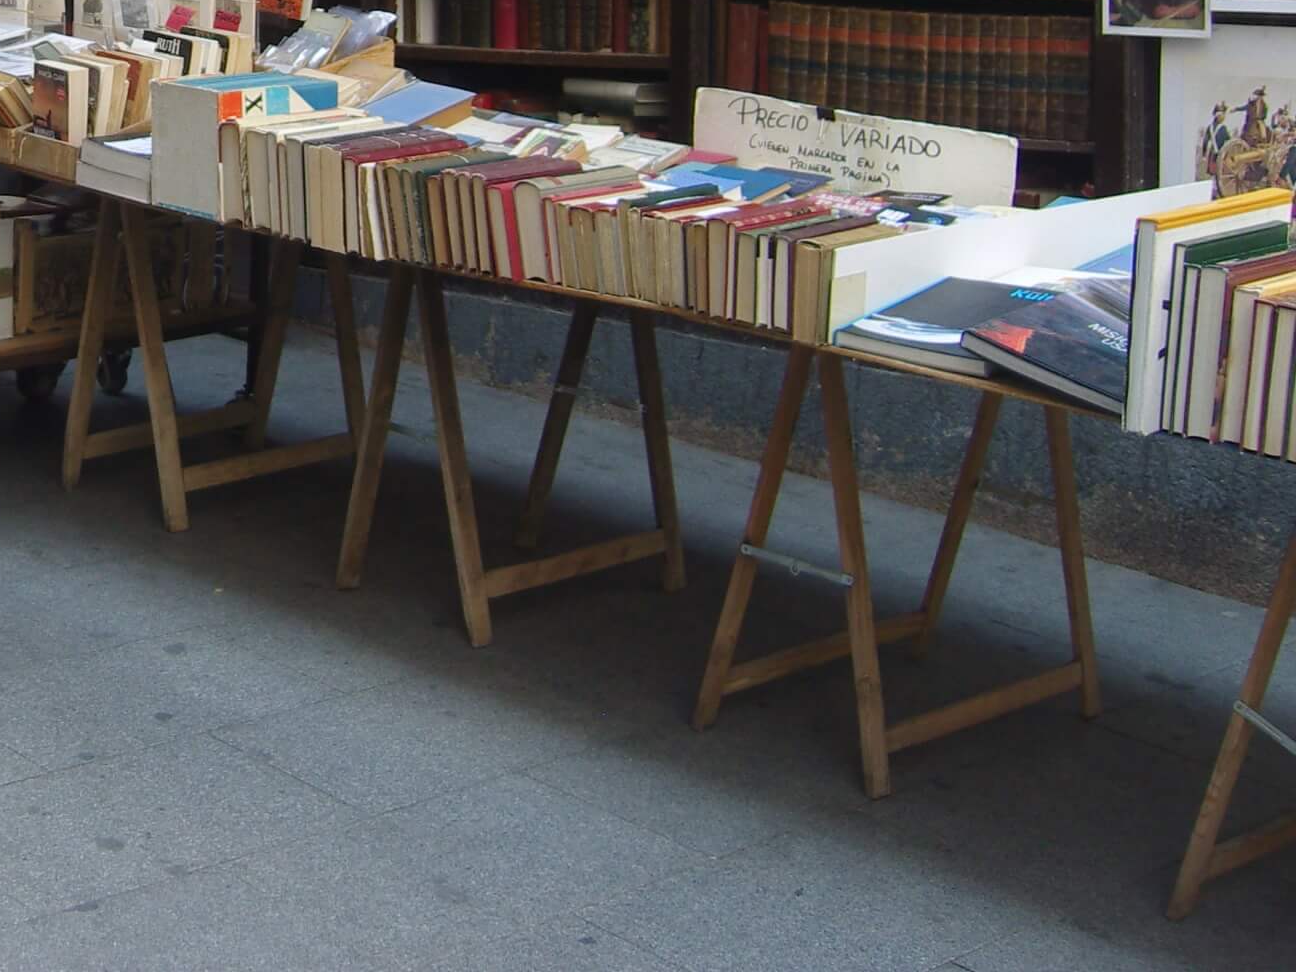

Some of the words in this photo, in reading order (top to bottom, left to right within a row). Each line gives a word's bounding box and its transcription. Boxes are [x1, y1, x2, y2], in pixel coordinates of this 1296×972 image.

[156, 36, 181, 55] RUTH
[727, 95, 809, 132] PRECIO
[857, 156, 875, 170] EN
[886, 161, 900, 173] LA
